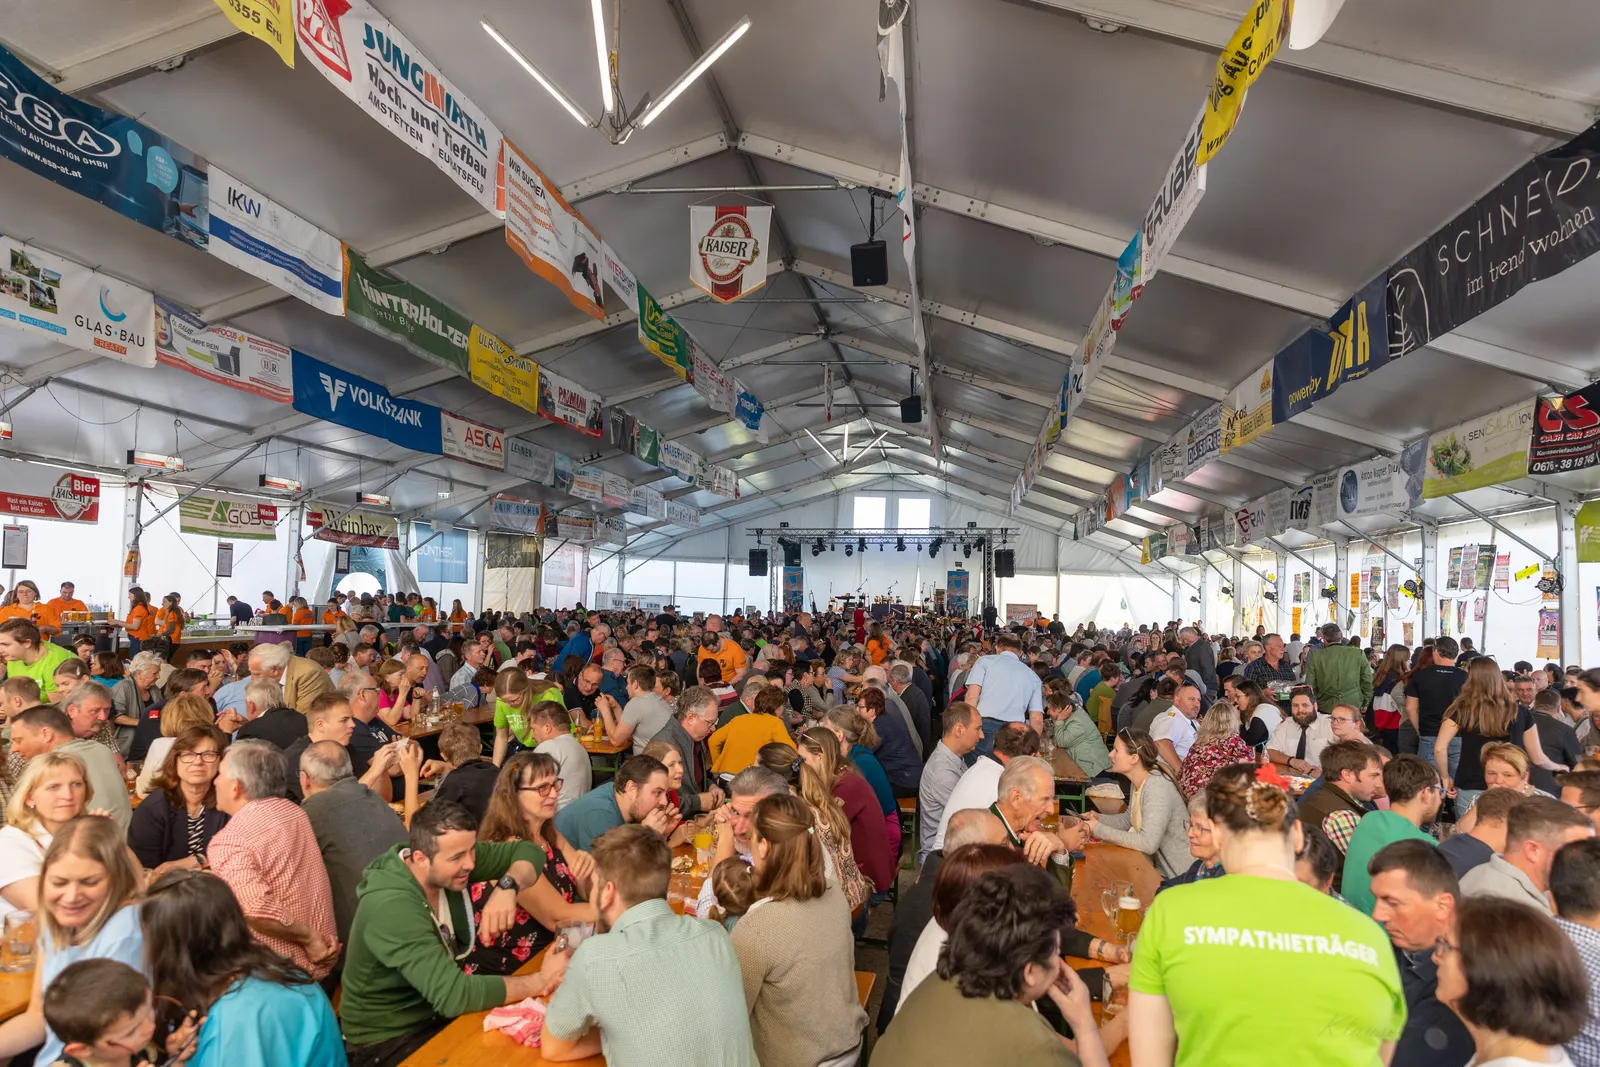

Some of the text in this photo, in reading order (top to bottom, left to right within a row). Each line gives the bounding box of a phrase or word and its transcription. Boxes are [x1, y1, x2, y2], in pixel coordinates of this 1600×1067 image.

[368, 91, 423, 144] AMSTETTEN
[29, 132, 81, 162] AUTOMATION
[82, 157, 109, 170] GMBH
[411, 106, 439, 137] und
[442, 127, 487, 179] Tiefbau
[508, 156, 521, 176] WIR
[1437, 157, 1600, 276] SCHNEID
[705, 238, 748, 257] KAISER
[1466, 205, 1596, 297] im trend wohnen
[94, 338, 127, 355] CREATIV
[1560, 458, 1573, 469] 38
[73, 479, 97, 493] Bier
[231, 502, 257, 511] ELEKTRO
[259, 508, 275, 517] Wein
[322, 507, 382, 538] Weinbar
[1183, 925, 1379, 967] SYMPATHIETRÄGER
